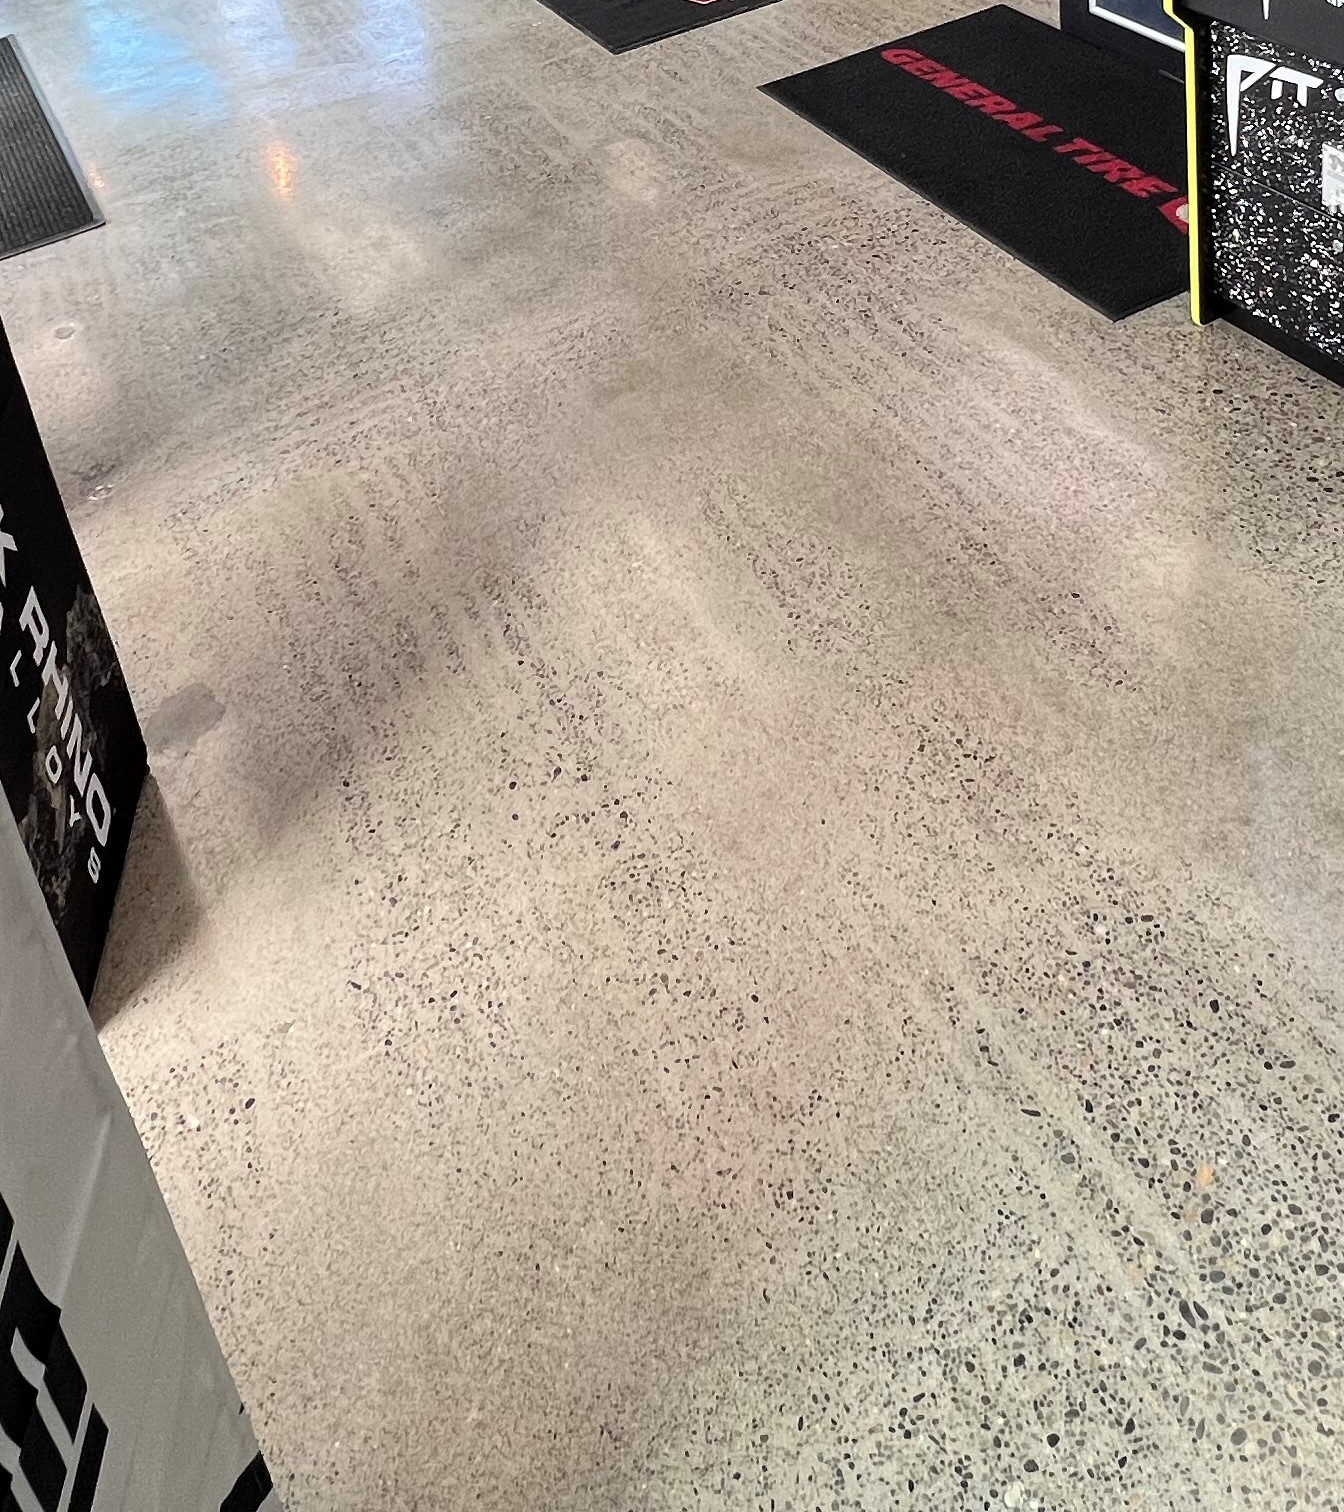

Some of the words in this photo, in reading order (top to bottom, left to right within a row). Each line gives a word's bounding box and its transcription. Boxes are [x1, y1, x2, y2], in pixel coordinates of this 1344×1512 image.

[881, 48, 1064, 143] GENERAL
[1052, 137, 1178, 198] TIRE
[1226, 54, 1324, 157] PIT
[19, 585, 112, 847] RHINO
